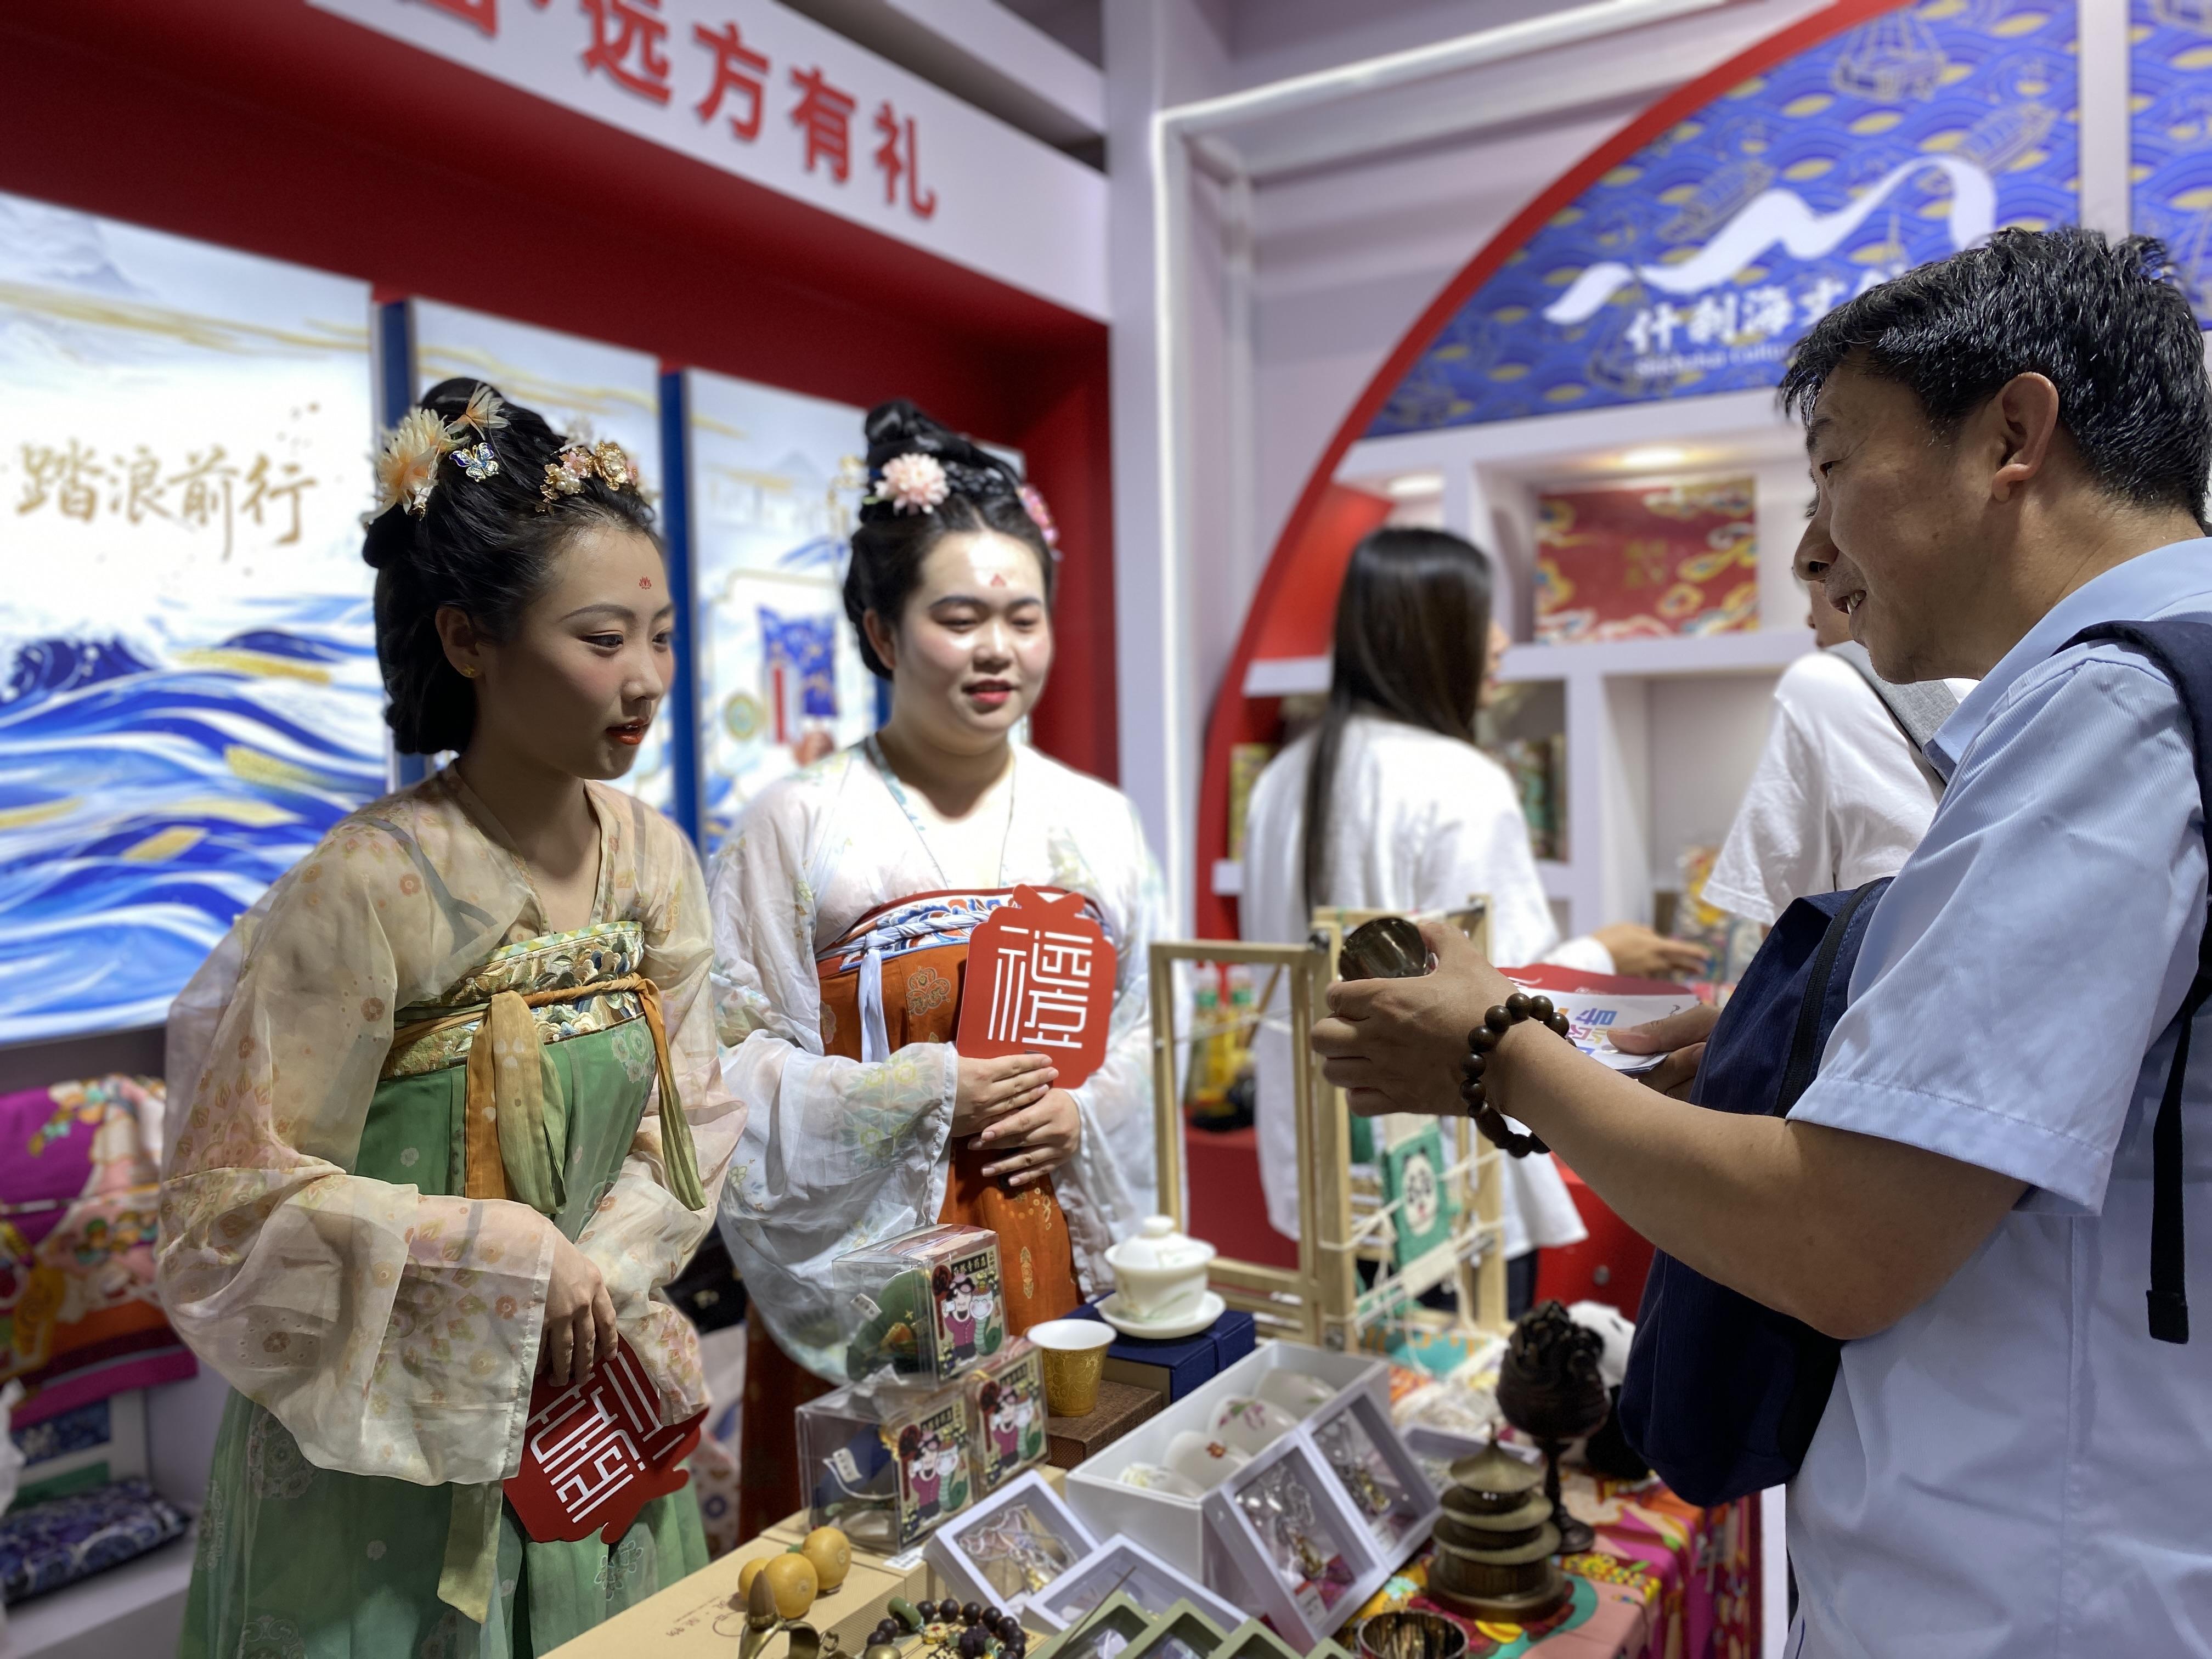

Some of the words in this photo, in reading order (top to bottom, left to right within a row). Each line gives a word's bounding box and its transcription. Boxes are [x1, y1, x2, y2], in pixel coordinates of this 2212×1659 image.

[1625, 266, 1906, 353] 什刹海文
[15, 438, 317, 562] 踏浪前行
